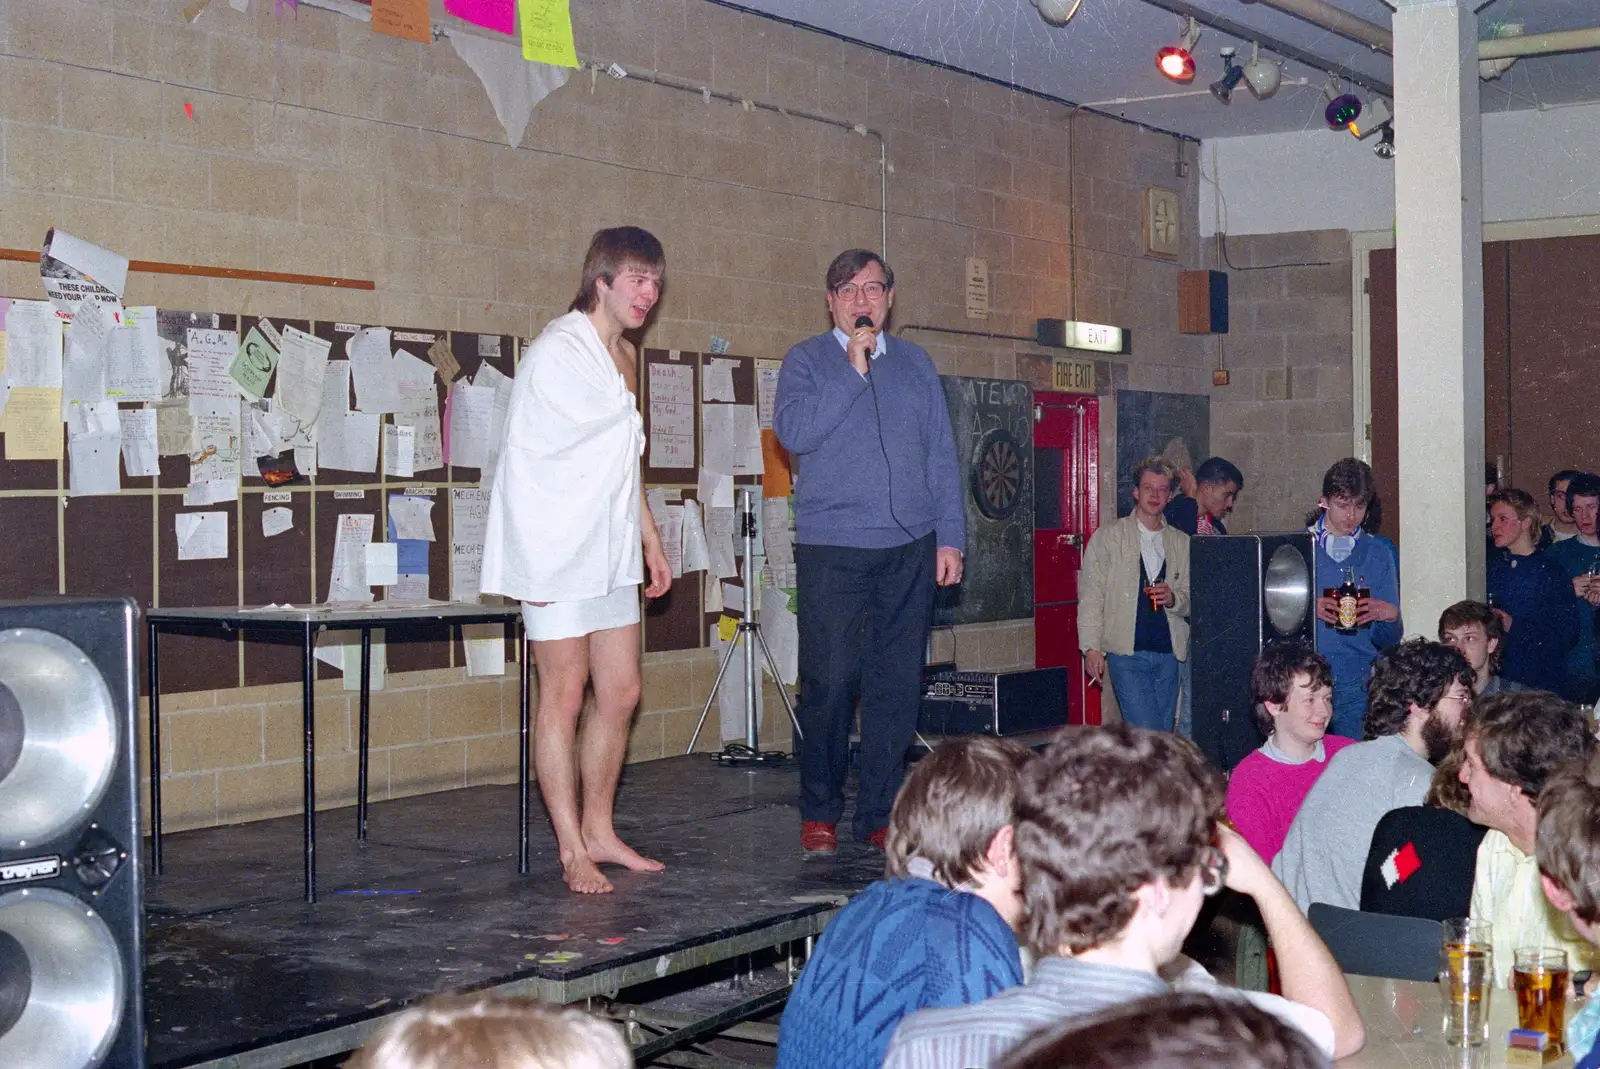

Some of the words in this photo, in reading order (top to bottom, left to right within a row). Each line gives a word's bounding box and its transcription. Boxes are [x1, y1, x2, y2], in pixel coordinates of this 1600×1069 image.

[59, 282, 80, 292] THESE
[80, 284, 114, 294] CHILDRE
[47, 290, 62, 300] NEED
[63, 293, 81, 301] YOUR
[335, 323, 361, 333] WALKING
[1088, 327, 1108, 345] EXIT
[650, 364, 677, 378] Death
[1056, 361, 1073, 388] FIRE
[1075, 363, 1092, 389] EXIT
[653, 403, 662, 416] My
[264, 493, 290, 502] FENCING
[335, 491, 363, 499] SWIMMING
[454, 490, 474, 500] MECH
[454, 544, 474, 555] MECH
